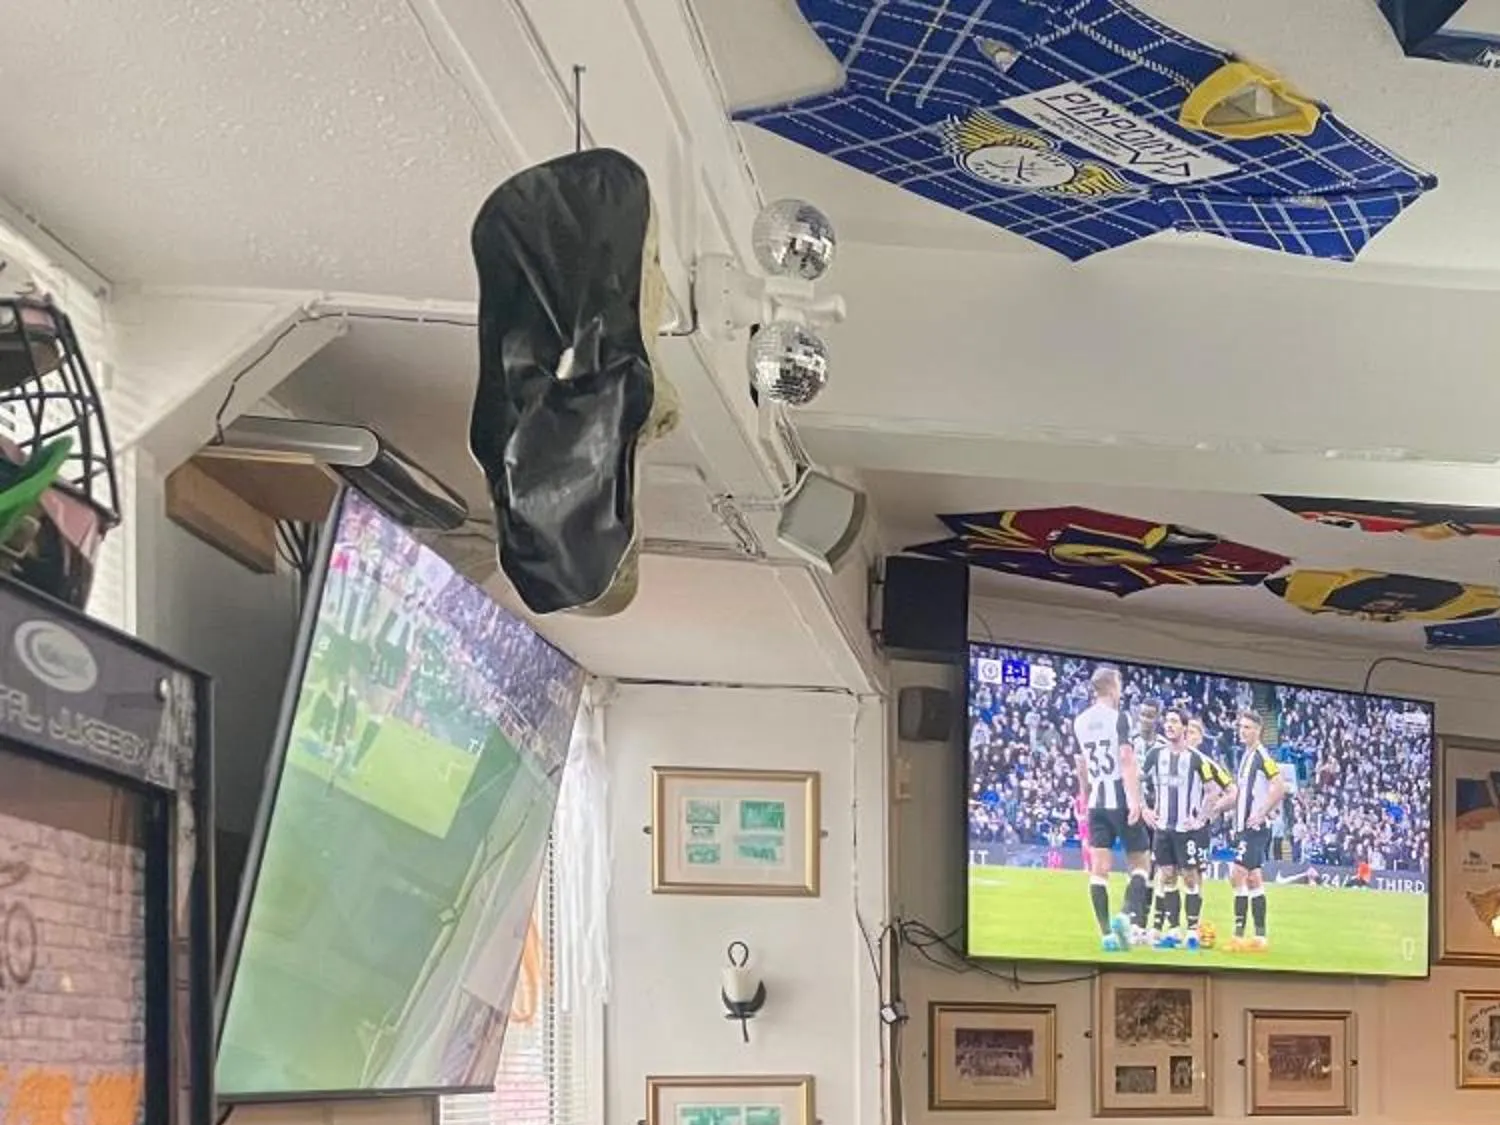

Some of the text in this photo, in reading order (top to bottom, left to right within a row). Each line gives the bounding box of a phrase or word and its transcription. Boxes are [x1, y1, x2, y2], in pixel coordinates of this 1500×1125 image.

[1045, 86, 1202, 164] PINPOINT
[1084, 739, 1116, 779] 33
[1186, 839, 1196, 856] 8
[1376, 876, 1425, 894] THIRD
